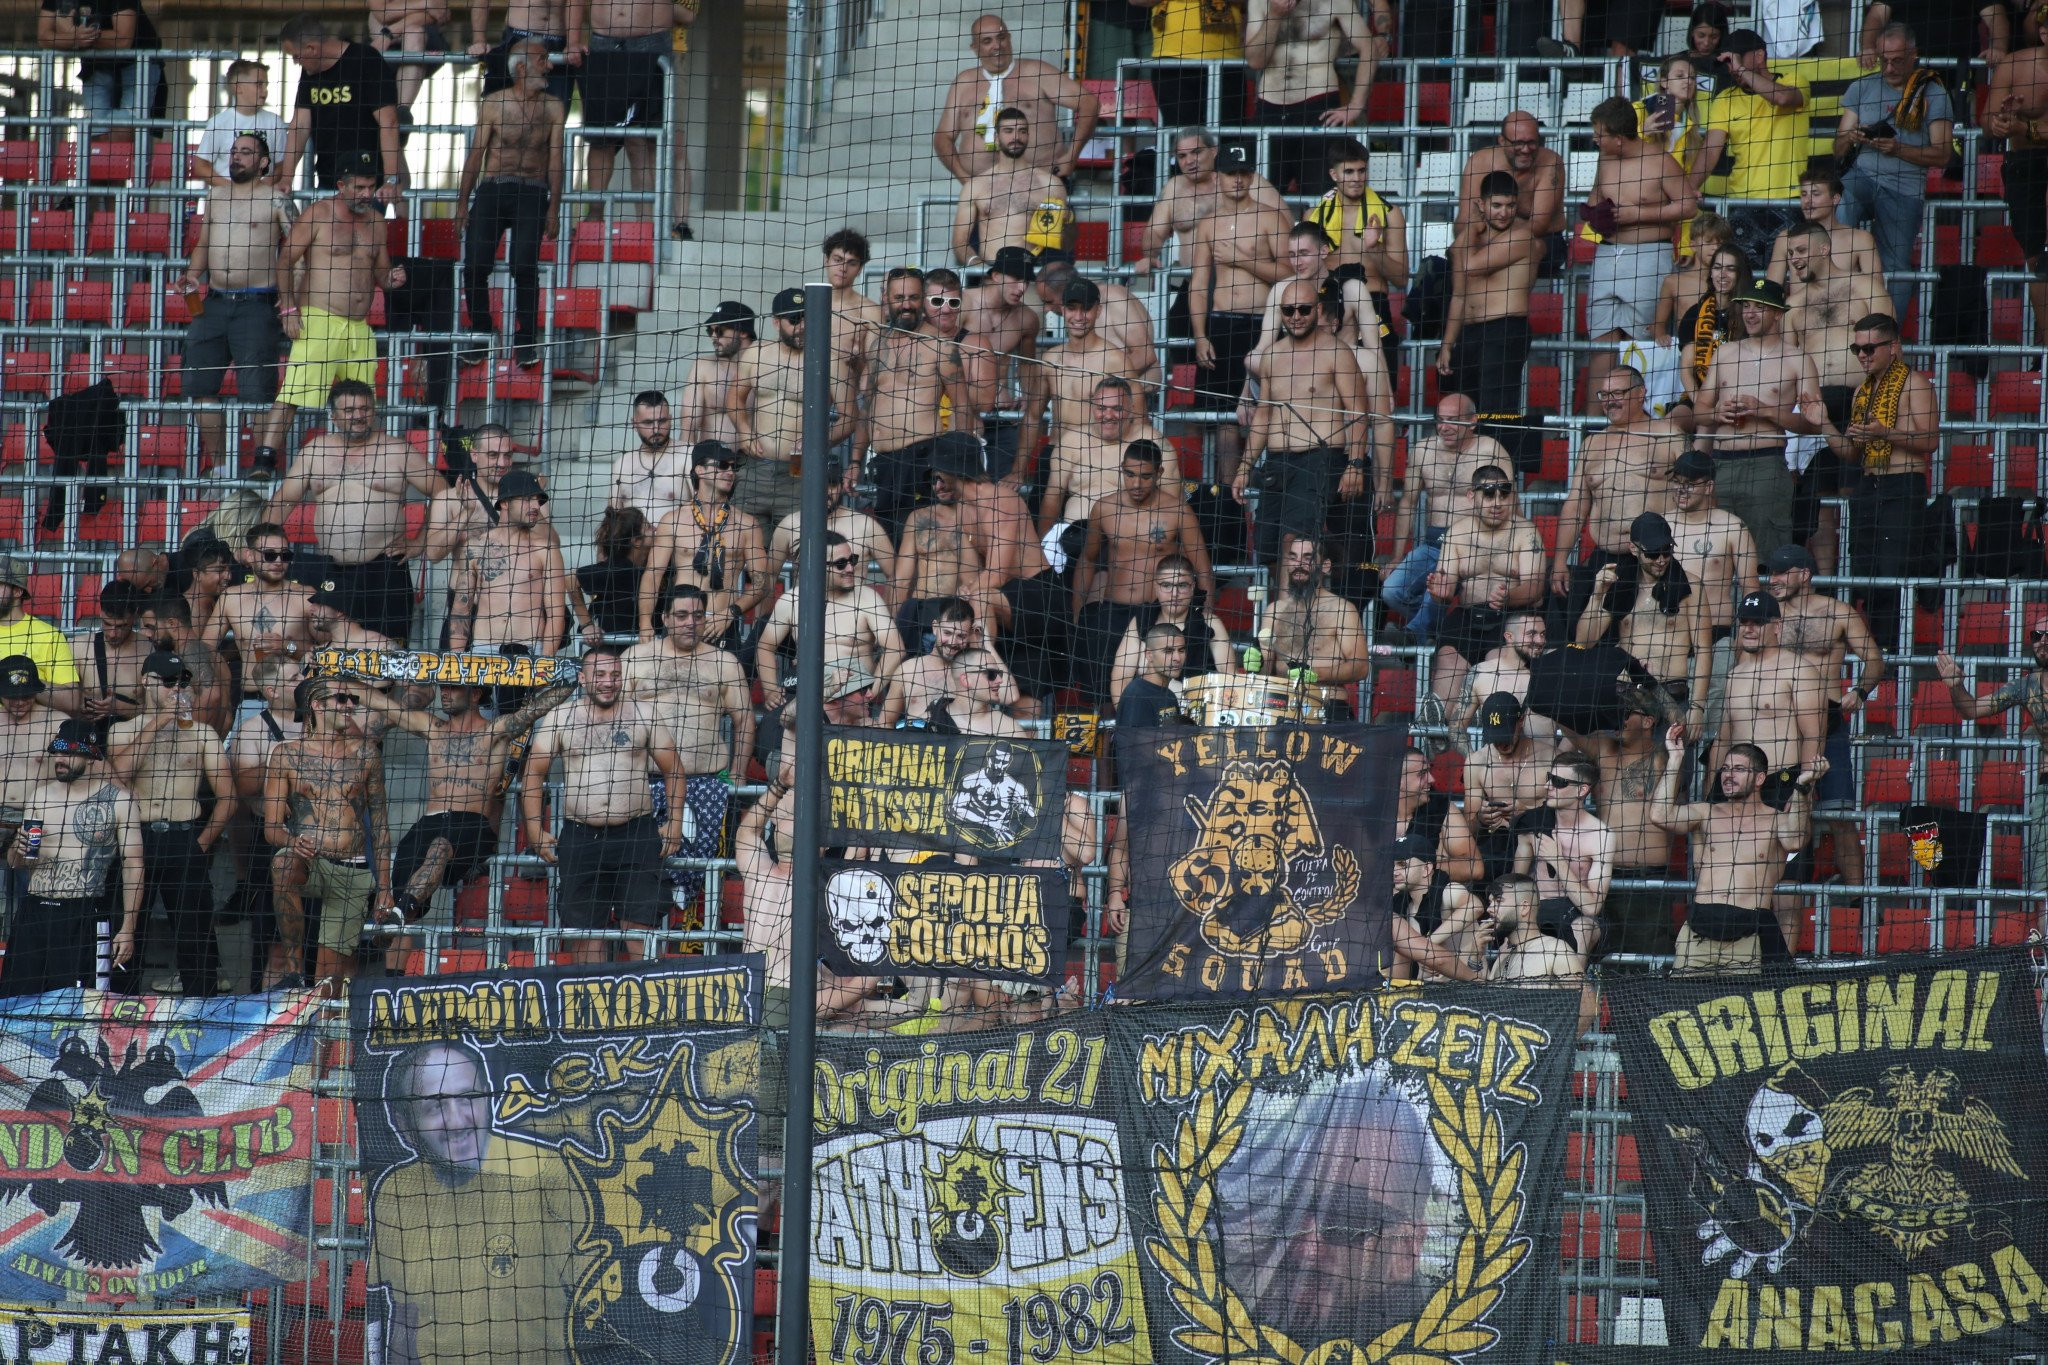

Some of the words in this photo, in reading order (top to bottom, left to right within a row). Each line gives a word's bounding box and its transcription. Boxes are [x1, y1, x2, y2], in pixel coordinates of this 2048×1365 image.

[310, 86, 352, 105] BOSS
[416, 653, 555, 686] PATRAS
[827, 739, 947, 788] ORIGINAL
[1157, 728, 1363, 776] YELLOW
[830, 786, 947, 835] PATISSIA
[897, 873, 1041, 924] SEPOLIA
[889, 919, 1050, 976] COLONOS
[1161, 943, 1347, 992] SQUAD
[1648, 969, 2000, 1090] ORIGINAL
[814, 1038, 1031, 1134] Original
[1039, 1028, 1108, 1109] 21
[162, 1105, 295, 1178] CLUB
[814, 1123, 1121, 1275] ATHENS
[10, 1252, 101, 1293] ALWAYS
[107, 1276, 138, 1295] ON
[144, 1258, 208, 1293] TOUR
[829, 1293, 953, 1365] 1975
[1002, 1269, 1136, 1365] 1982
